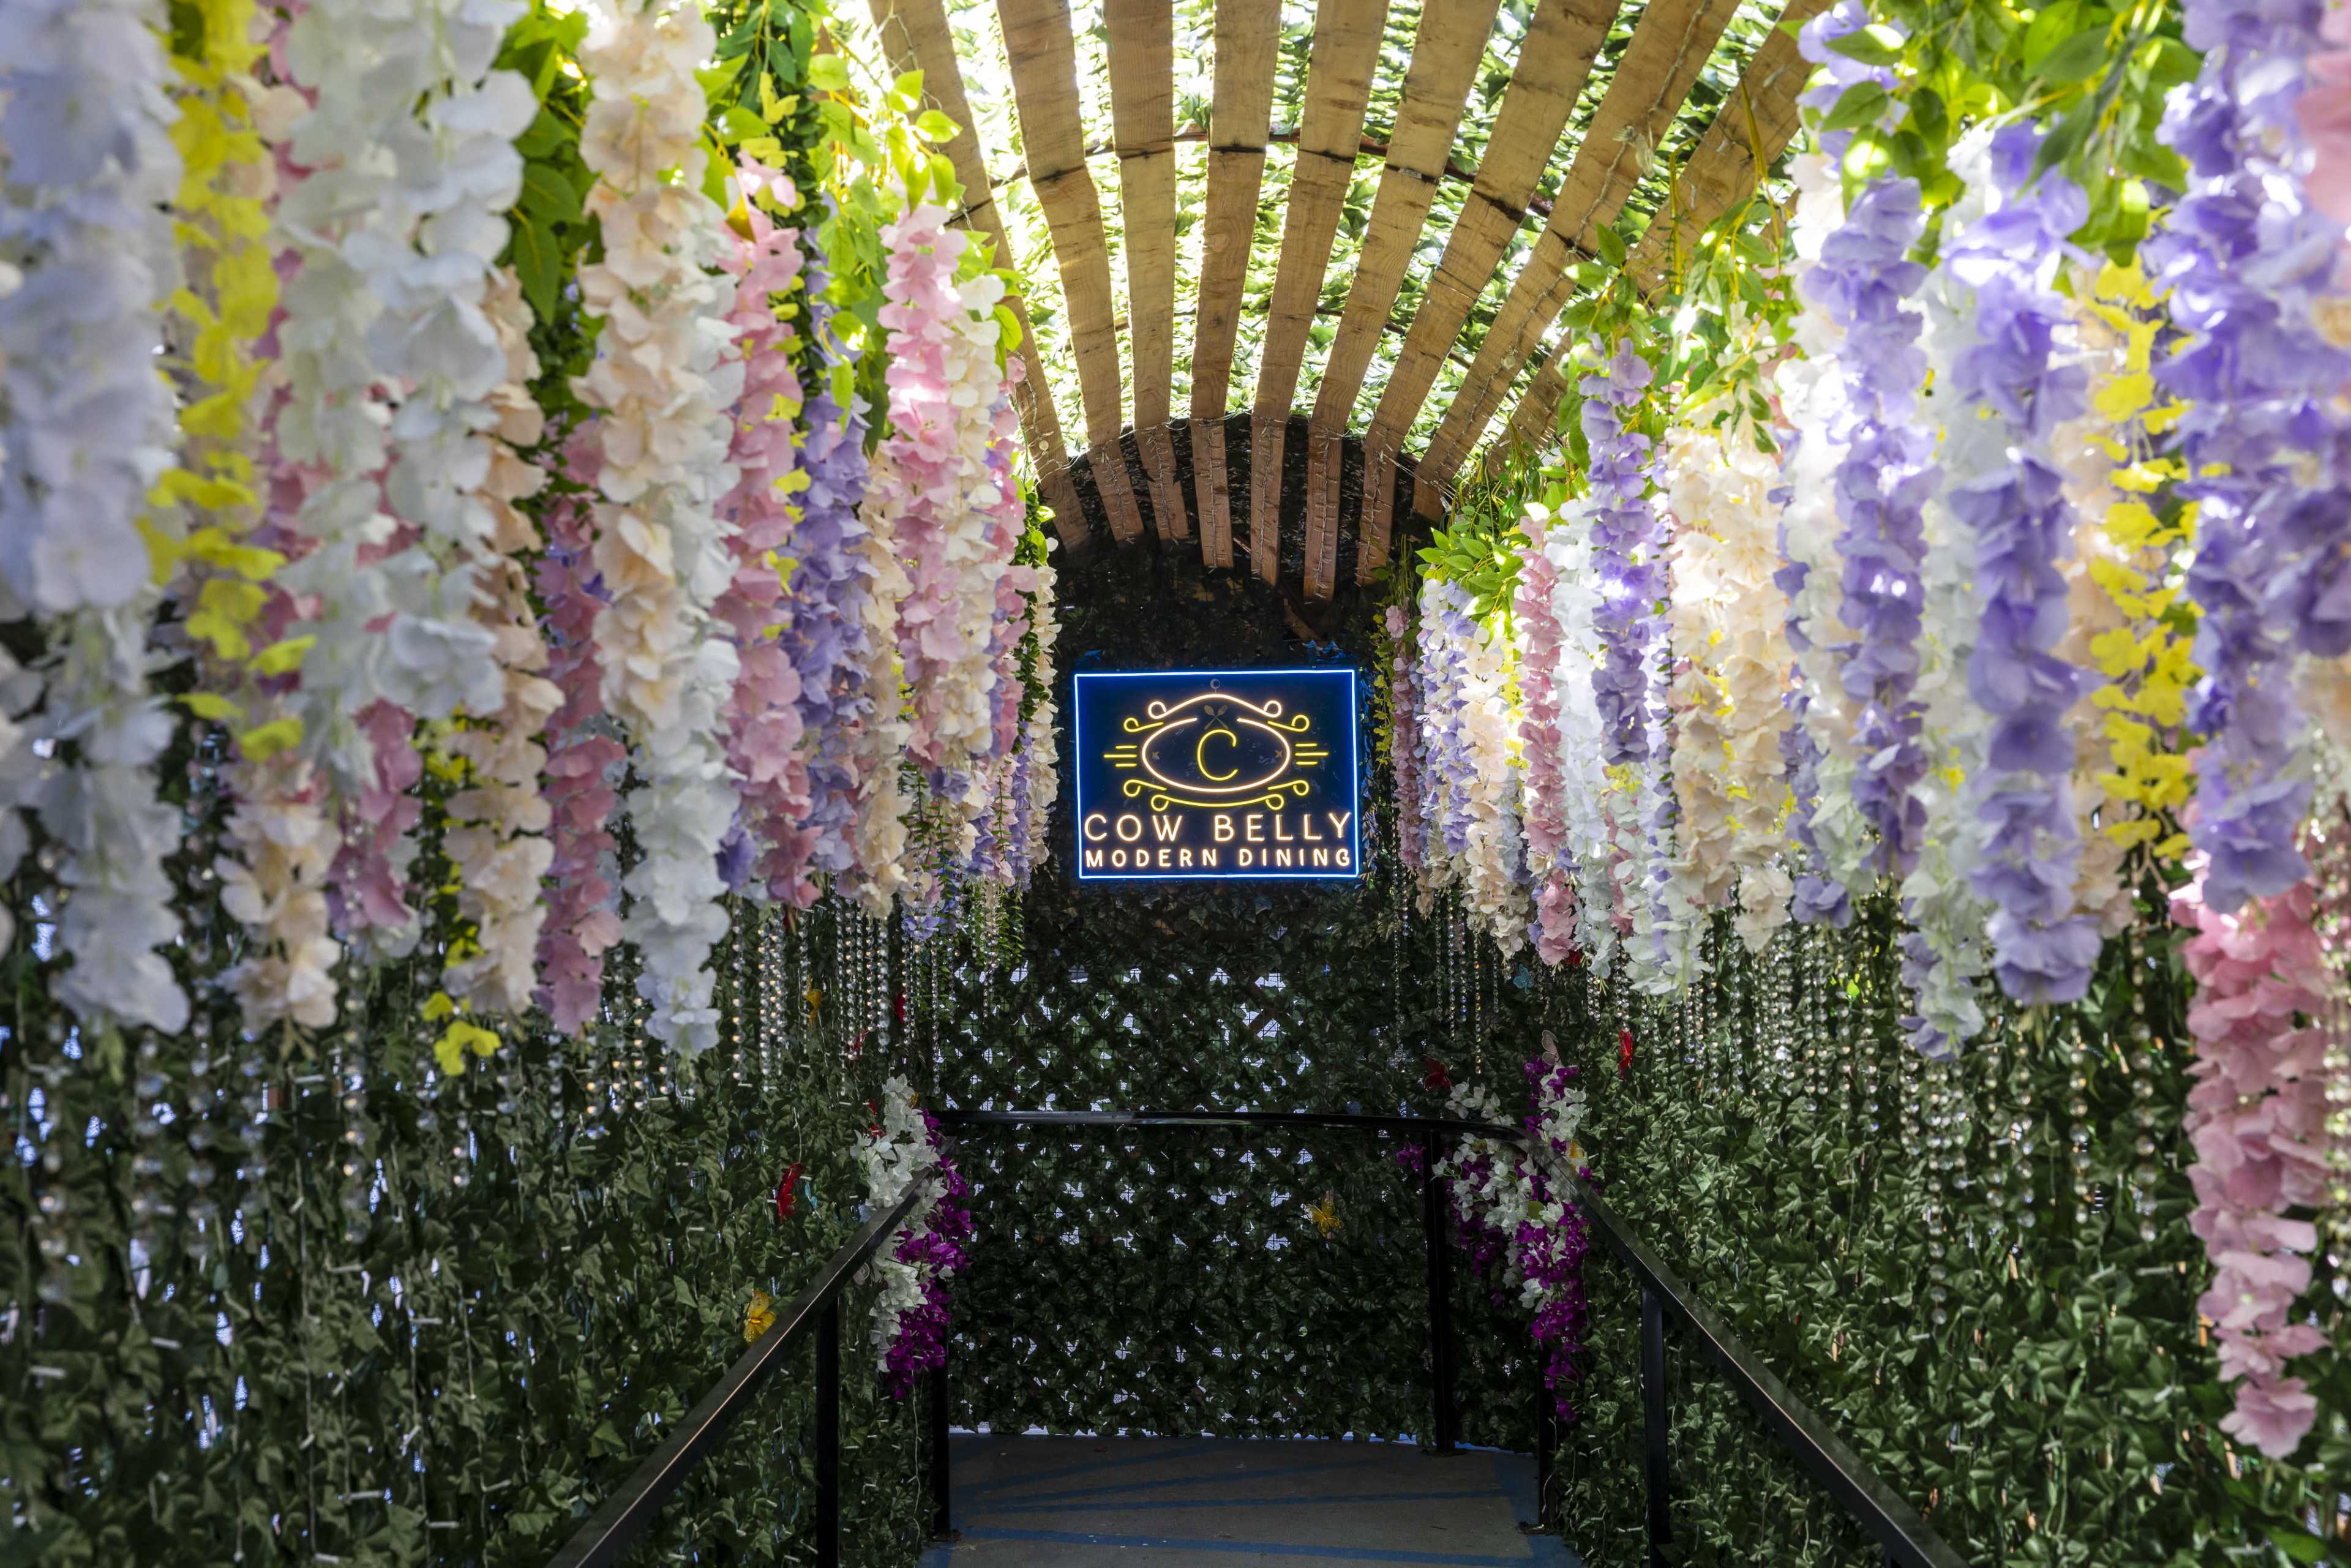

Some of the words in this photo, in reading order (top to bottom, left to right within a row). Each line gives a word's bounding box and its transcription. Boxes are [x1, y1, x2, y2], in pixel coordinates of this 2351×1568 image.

[1198, 729, 1239, 781] C
[1084, 813, 1182, 841] COW
[1214, 811, 1351, 842] BELLY
[1086, 849, 1217, 868] MODERN
[1239, 848, 1350, 867] DINING
